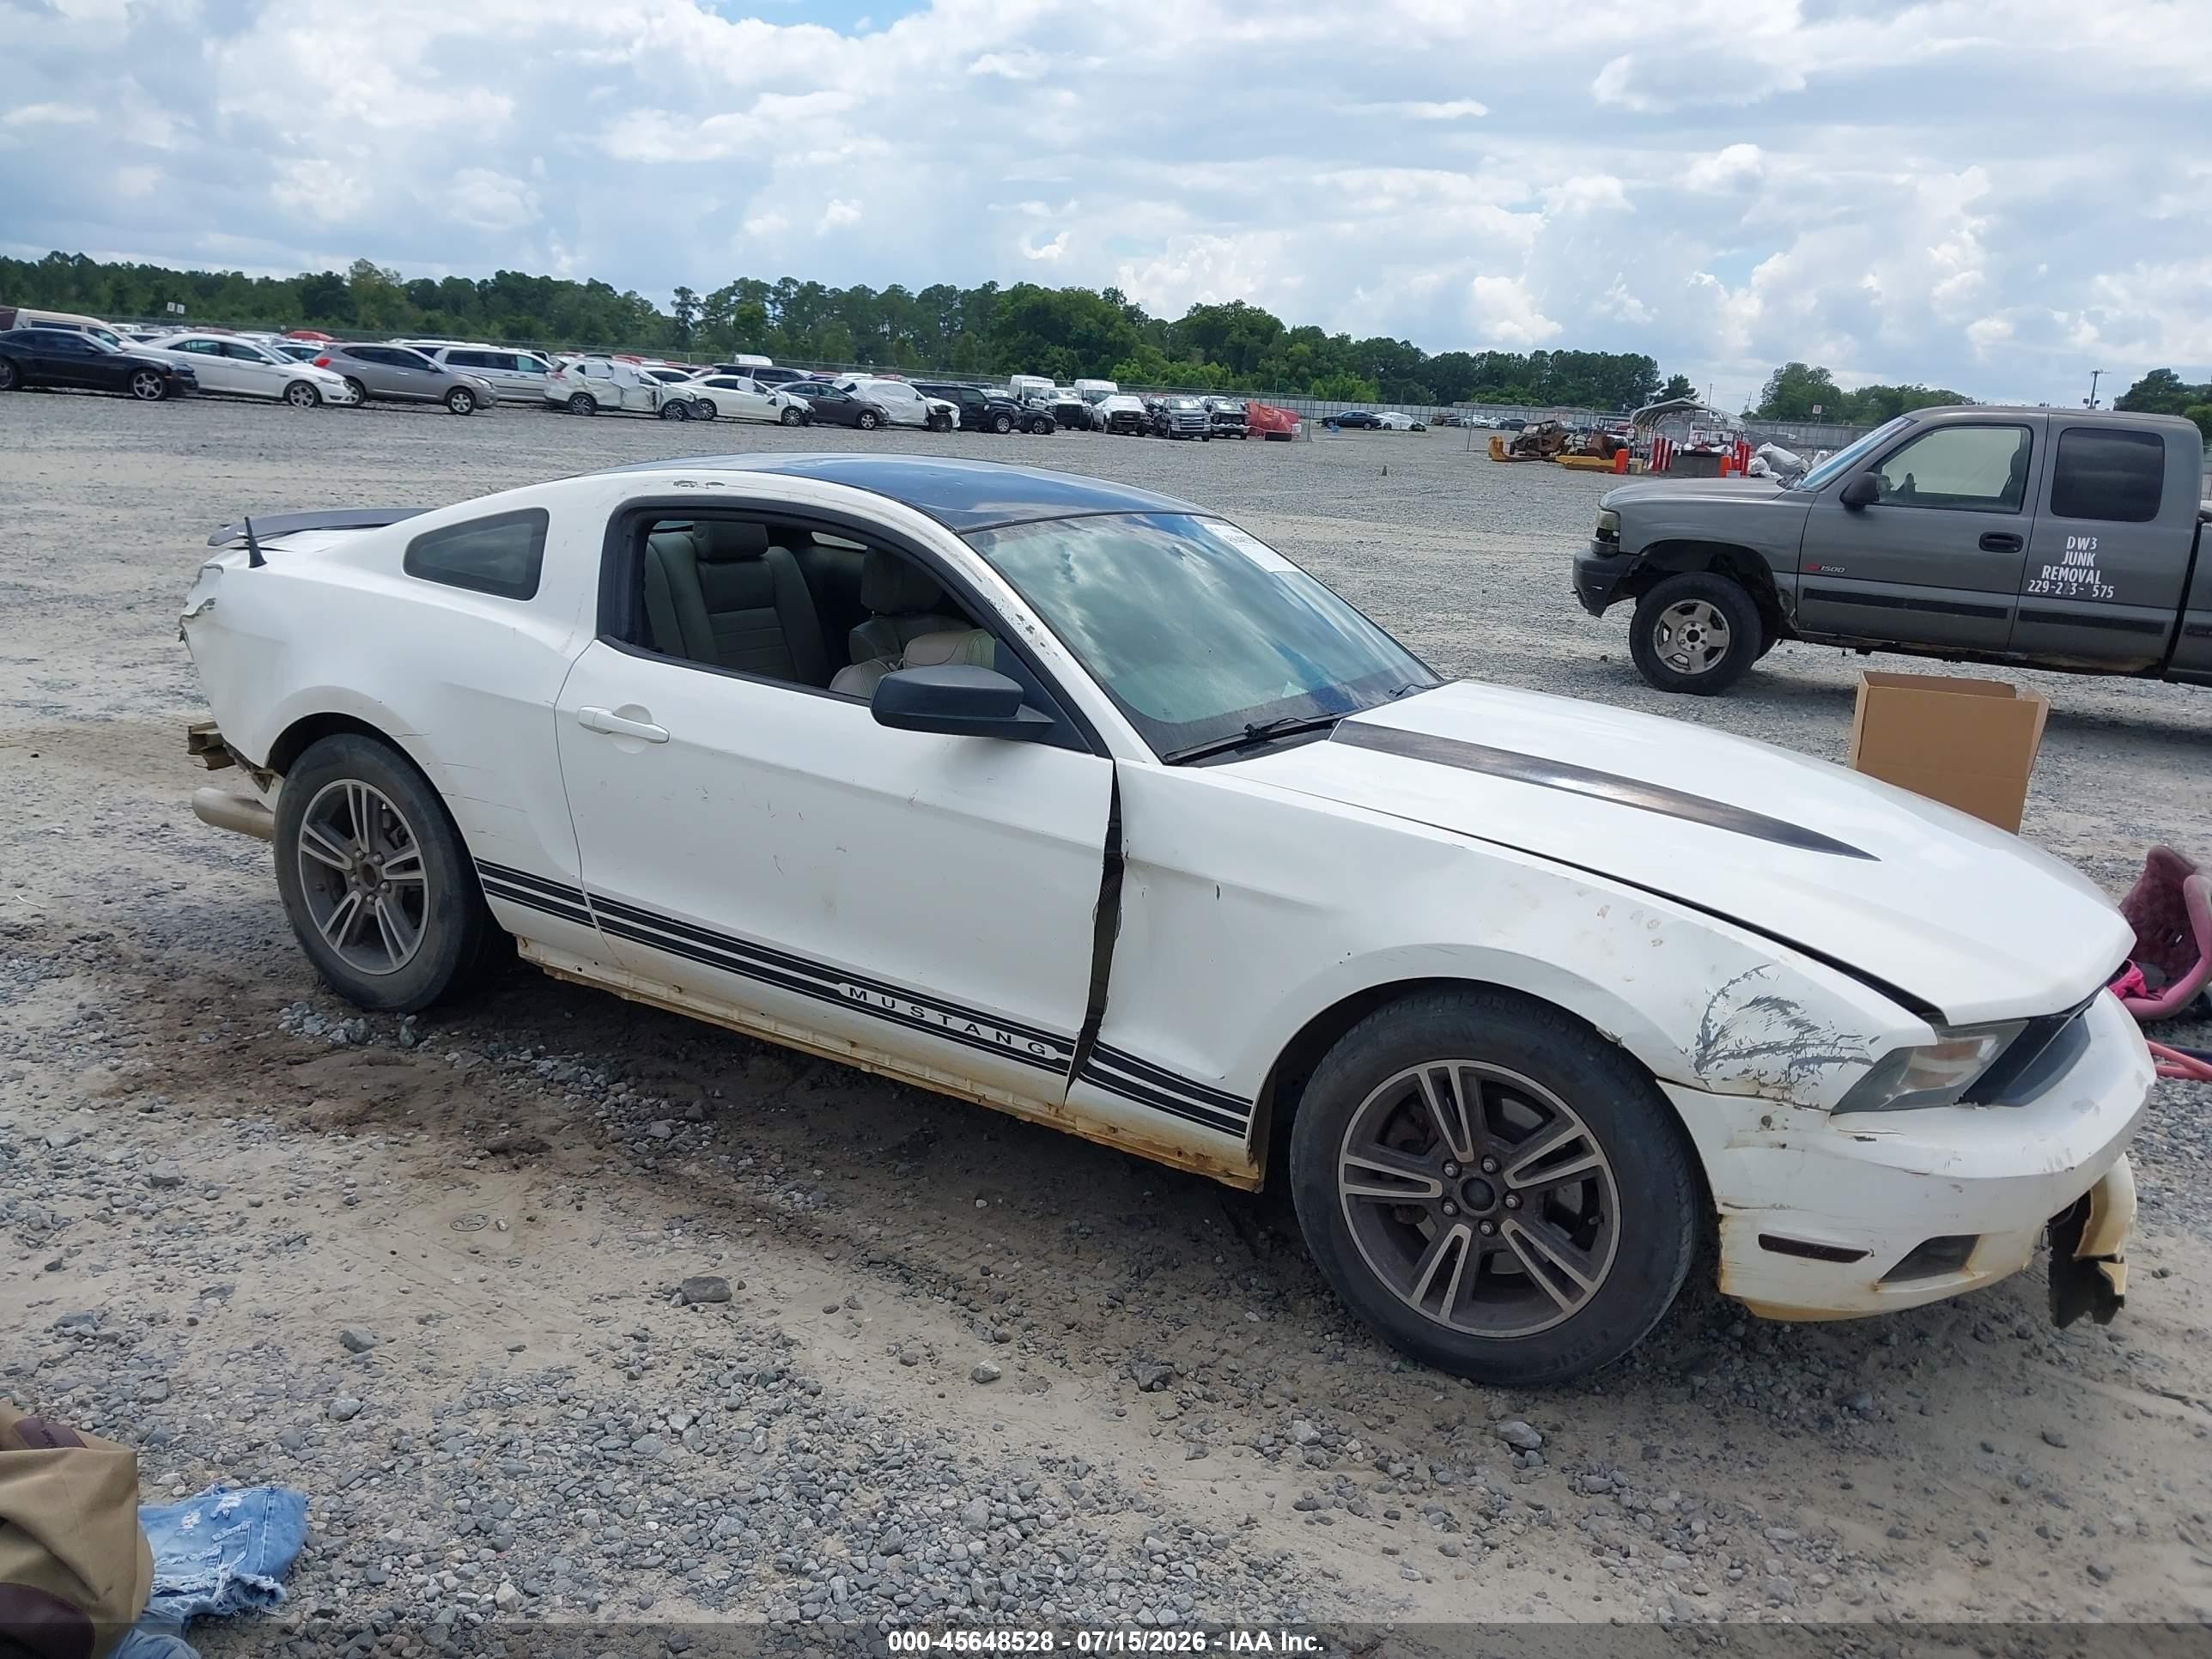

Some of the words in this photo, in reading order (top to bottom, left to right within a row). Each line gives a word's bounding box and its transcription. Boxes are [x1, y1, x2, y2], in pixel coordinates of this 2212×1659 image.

[2066, 536, 2098, 550] DW3
[2061, 550, 2096, 567] JUNK
[2041, 565, 2101, 584] REMOVAL
[849, 987, 1046, 1056] MUSTANG
